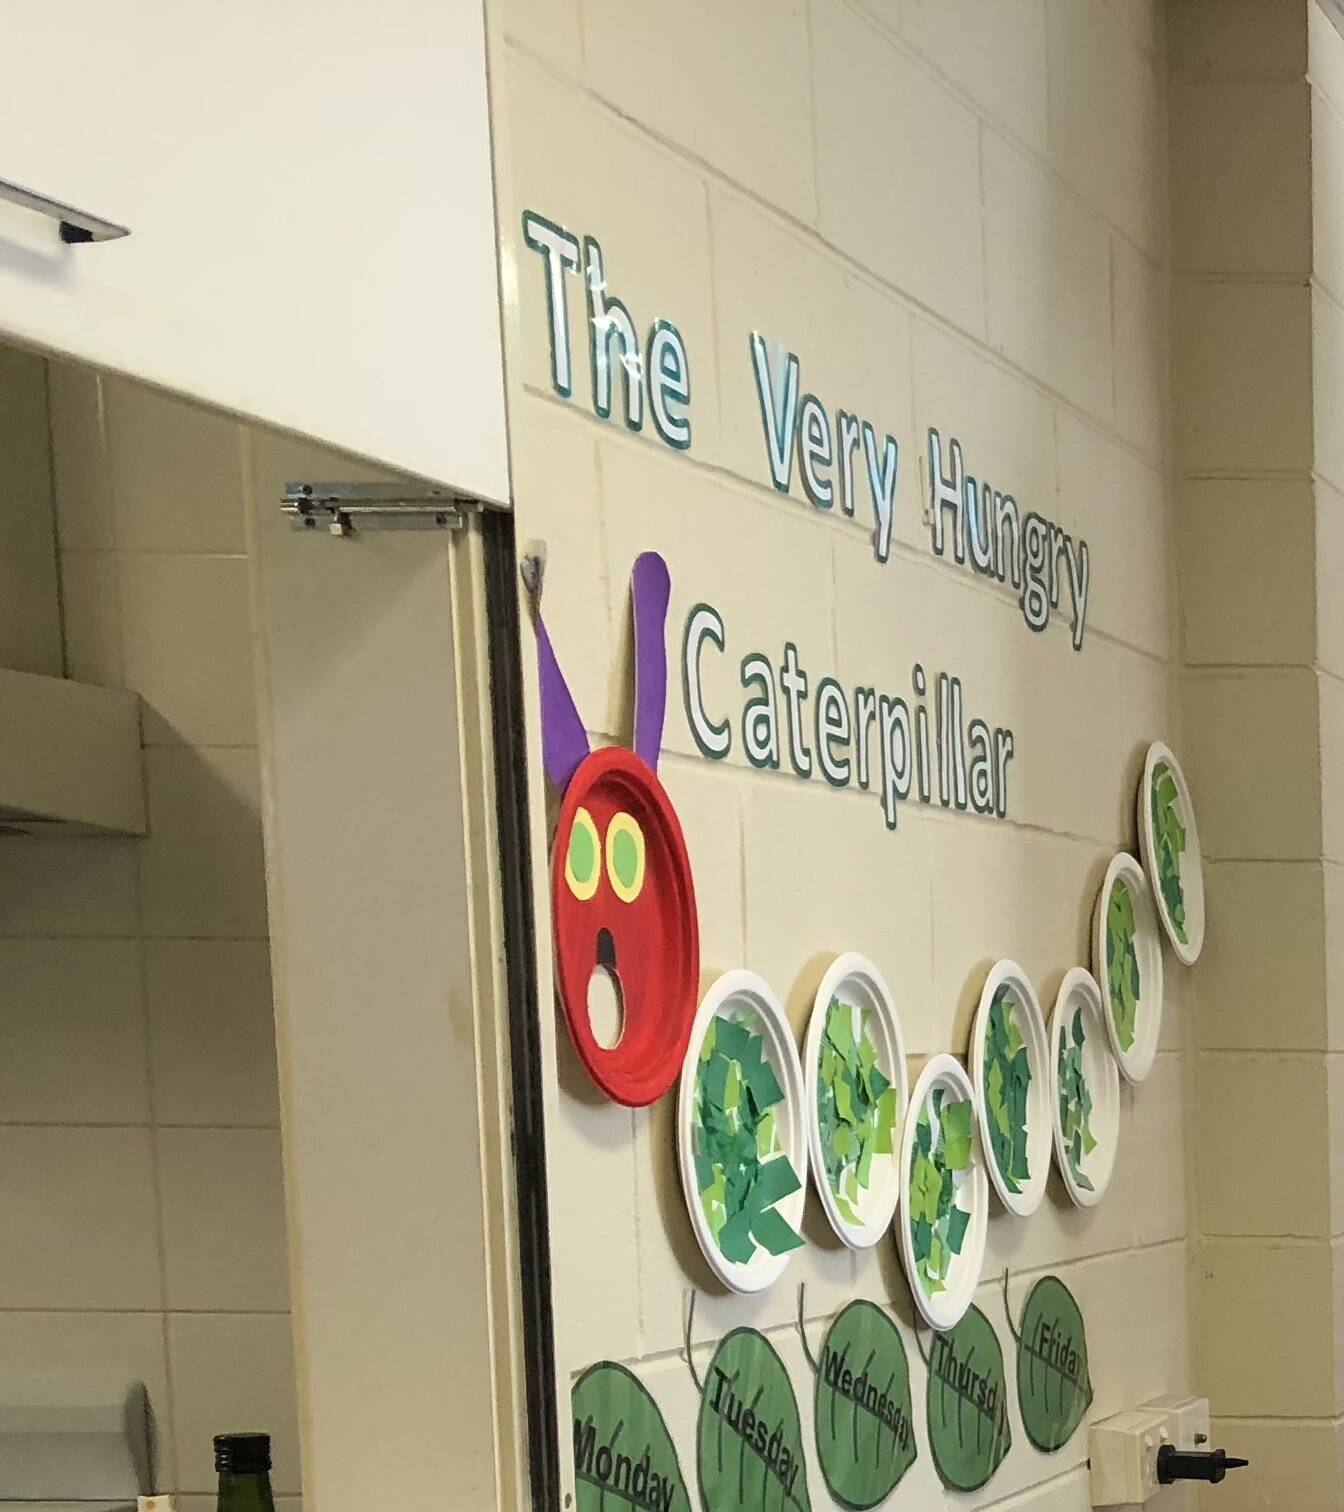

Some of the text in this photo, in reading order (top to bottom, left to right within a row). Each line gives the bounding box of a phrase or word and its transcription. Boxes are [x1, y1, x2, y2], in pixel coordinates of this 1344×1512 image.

[521, 208, 1090, 651] The Very Hungry
[682, 603, 1015, 829] Caterpillar
[712, 1364, 799, 1498] Tuesday
